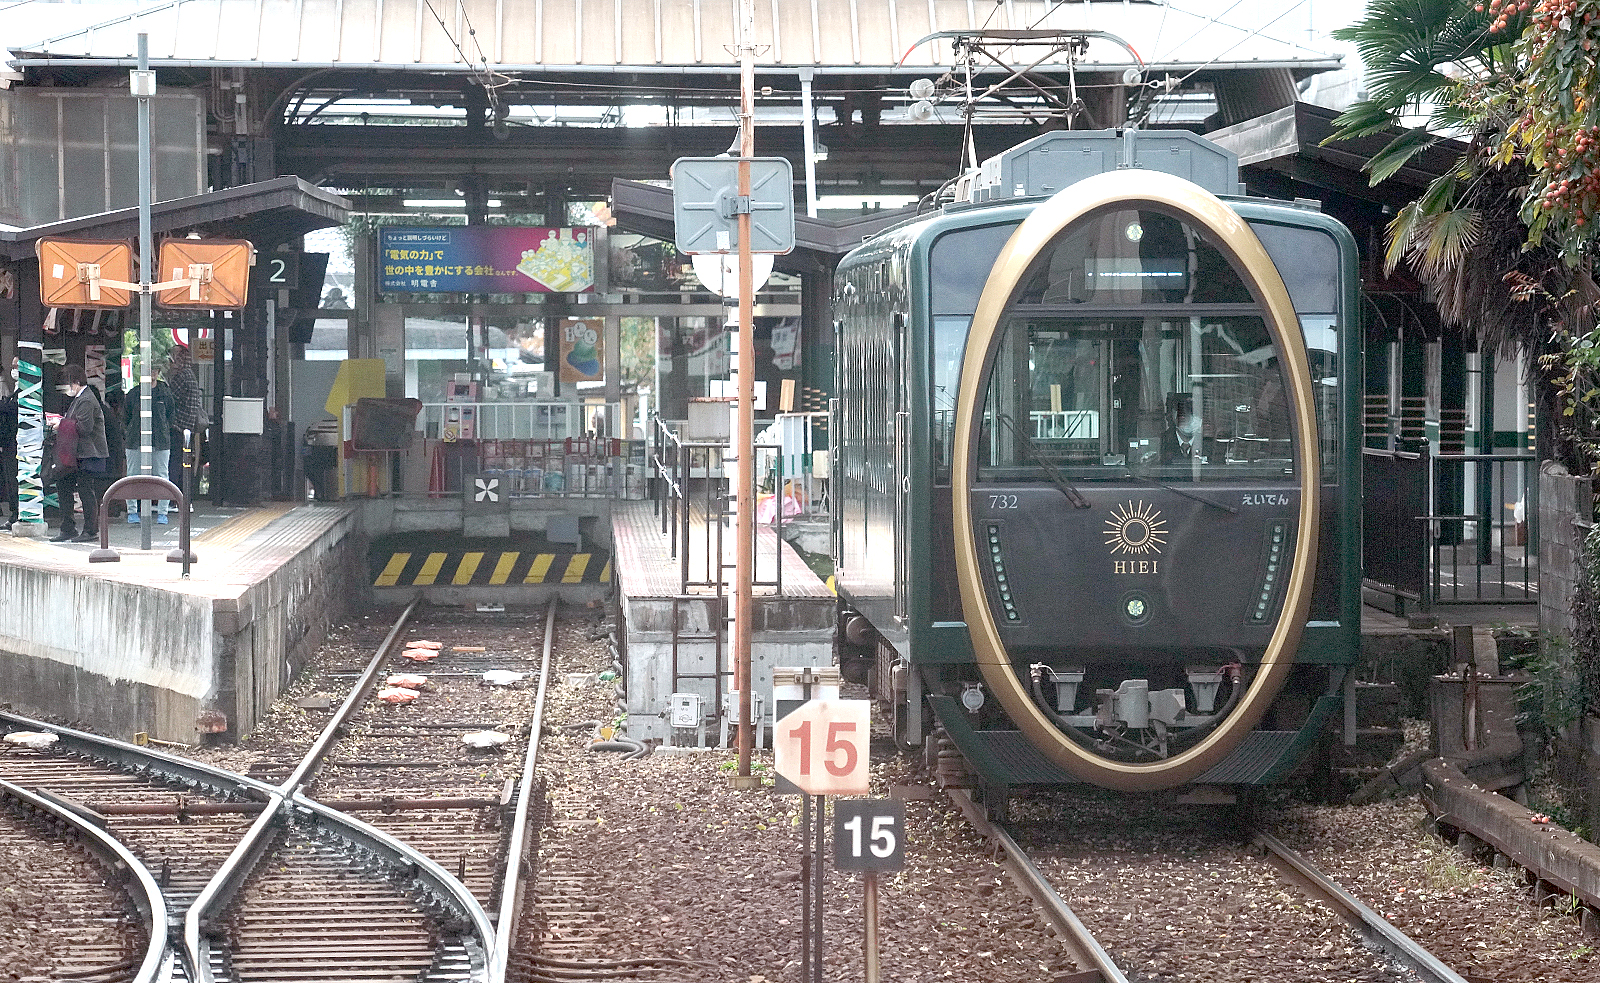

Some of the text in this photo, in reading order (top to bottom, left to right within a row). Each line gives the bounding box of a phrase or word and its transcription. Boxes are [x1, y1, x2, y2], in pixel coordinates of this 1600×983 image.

[385, 249, 444, 260] 「電気の力」で
[270, 259, 286, 282] 2
[989, 494, 1018, 509] 732
[1242, 493, 1289, 505] えいでん
[1114, 560, 1158, 574] HIEI
[789, 720, 858, 777] 15
[844, 815, 896, 859] 15
